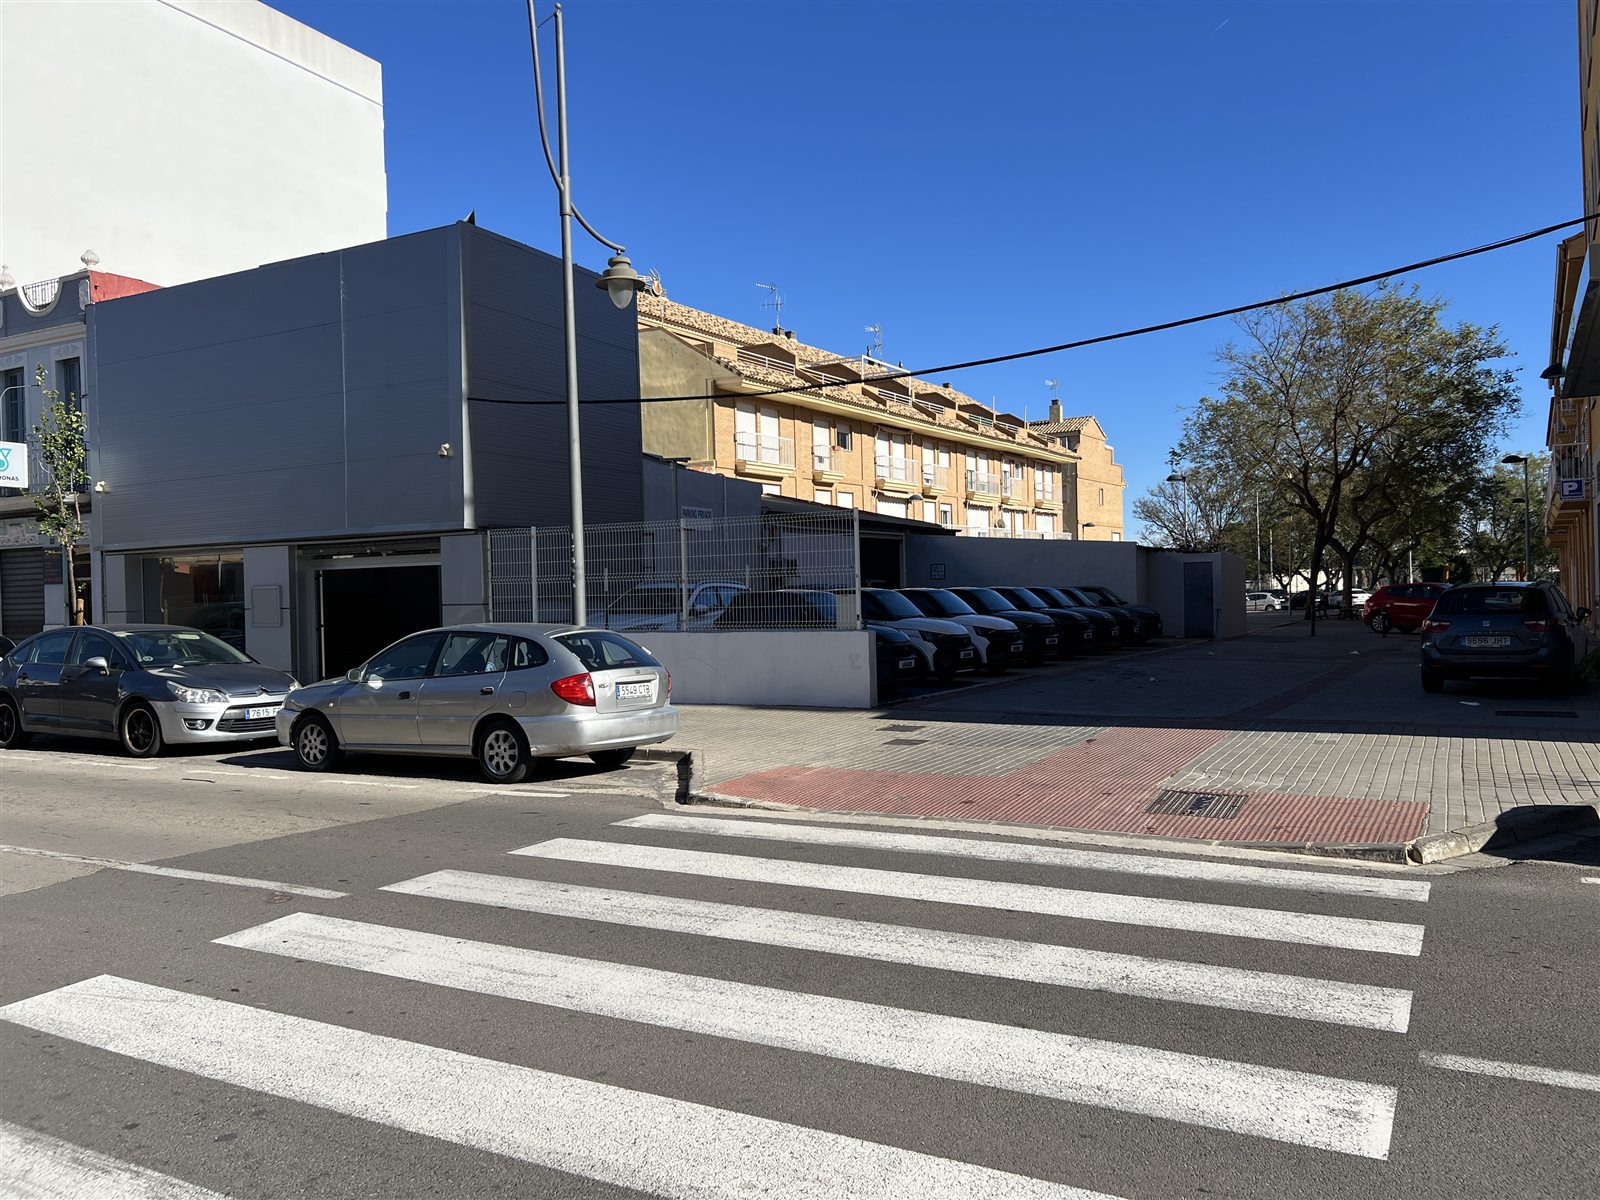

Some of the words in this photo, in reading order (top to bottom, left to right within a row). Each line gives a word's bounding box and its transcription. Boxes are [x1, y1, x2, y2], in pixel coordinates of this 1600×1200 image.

[1563, 482, 1578, 495] P
[1466, 637, 1489, 645] 9696
[621, 686, 637, 696] 5549
[638, 685, 650, 694] CTB
[252, 708, 270, 717] 7615
